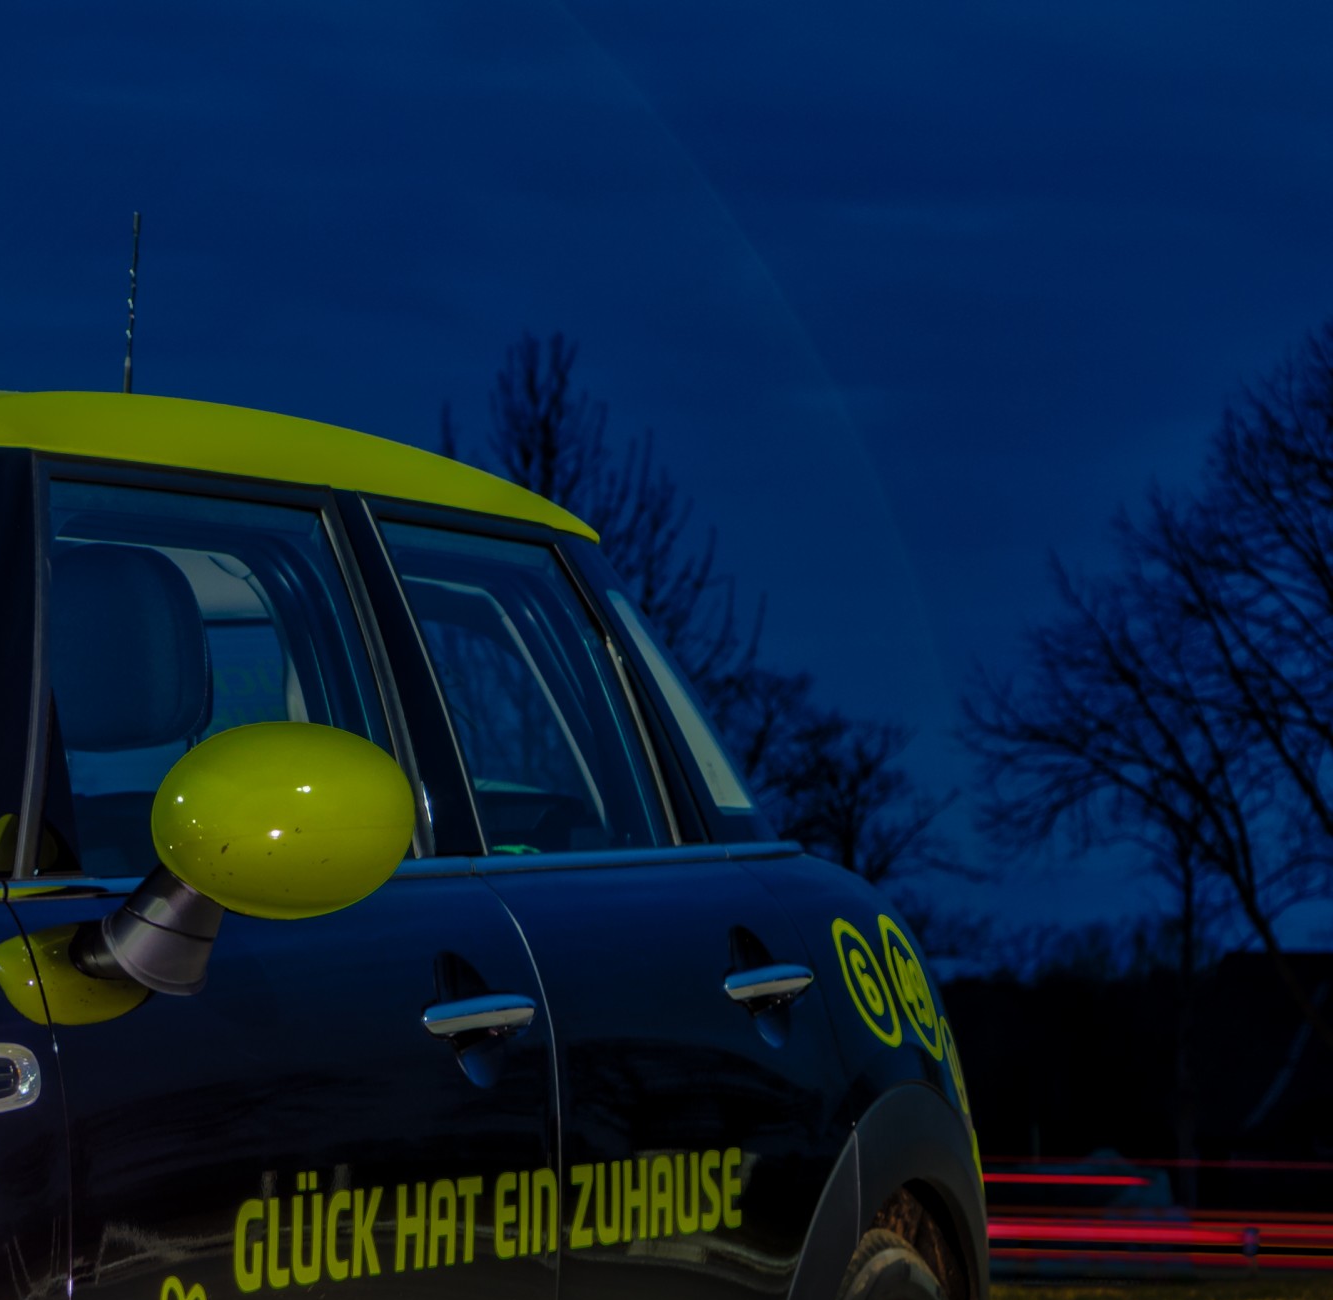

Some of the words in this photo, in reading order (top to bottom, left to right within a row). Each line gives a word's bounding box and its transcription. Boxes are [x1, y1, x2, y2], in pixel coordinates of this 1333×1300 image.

[848, 949, 884, 1016] 6
[233, 1172, 383, 1293] GLÜCK
[395, 1176, 483, 1272] HAT
[494, 1169, 559, 1260] EIN
[570, 1148, 742, 1250] ZUHAUSE
